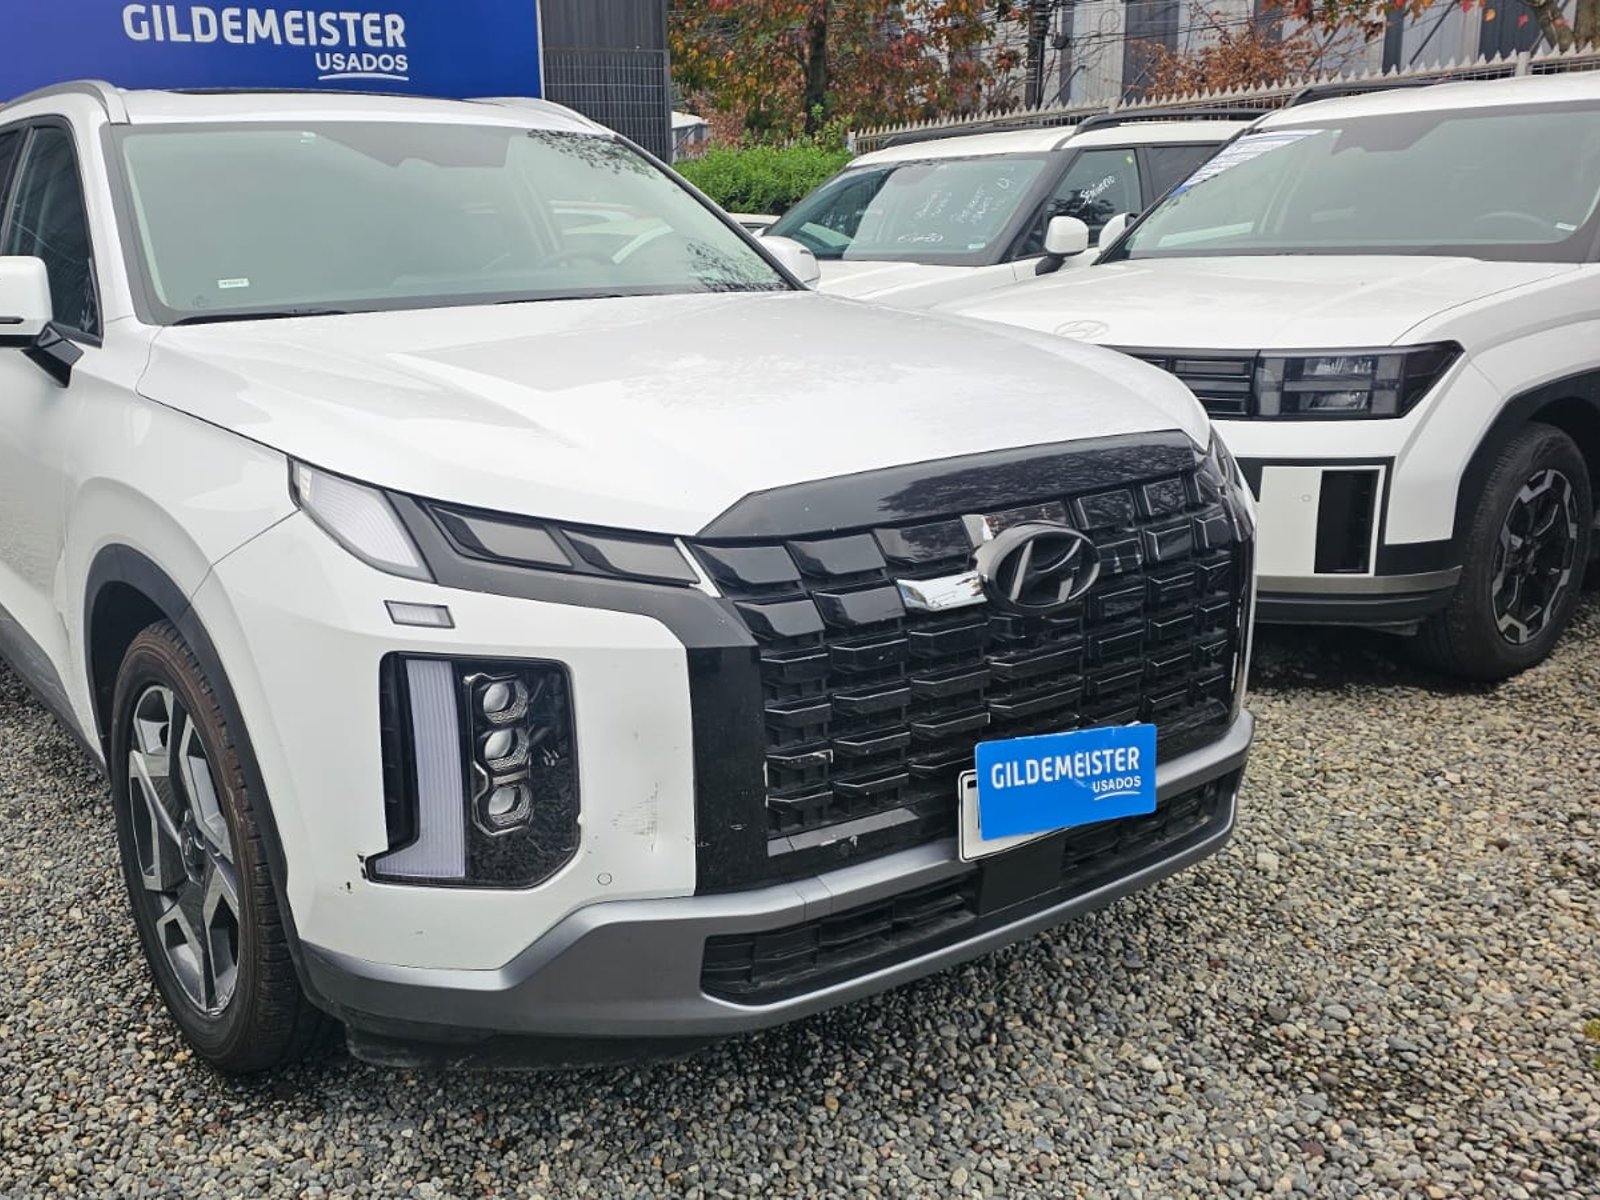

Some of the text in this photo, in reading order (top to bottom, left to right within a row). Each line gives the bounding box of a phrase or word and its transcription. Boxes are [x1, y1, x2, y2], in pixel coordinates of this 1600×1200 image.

[122, 4, 407, 48] GILDEMEISTER
[315, 52, 409, 72] USADOS
[991, 746, 1141, 789] GILDEMEISTER
[1092, 775, 1142, 793] USADOS
